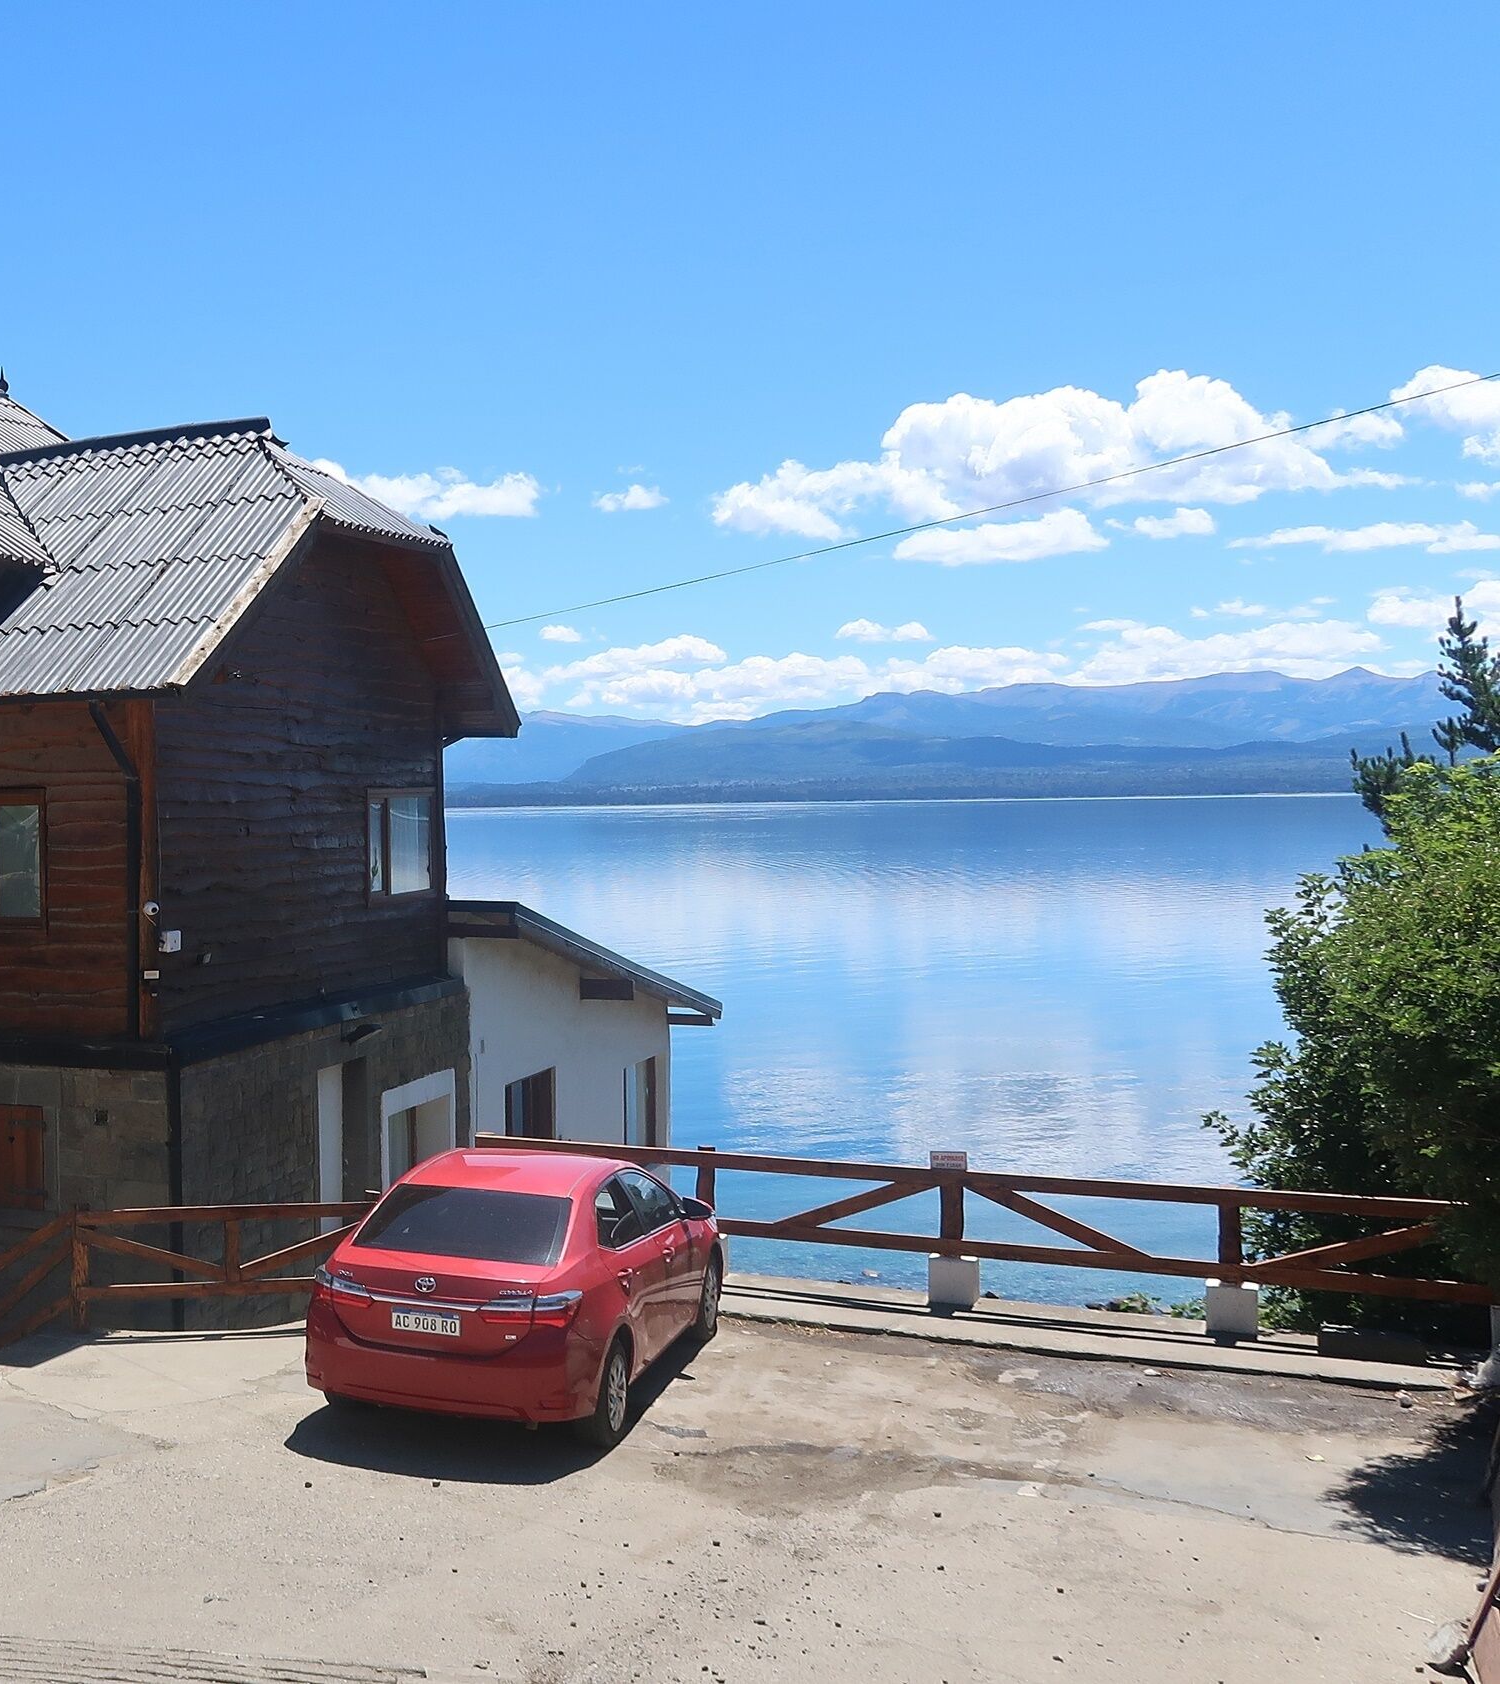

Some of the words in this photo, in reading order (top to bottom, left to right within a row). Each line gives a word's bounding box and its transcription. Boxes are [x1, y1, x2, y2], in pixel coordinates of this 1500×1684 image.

[395, 1314, 410, 1328] AC
[414, 1316, 437, 1332] 908
[441, 1319, 457, 1334] RO
